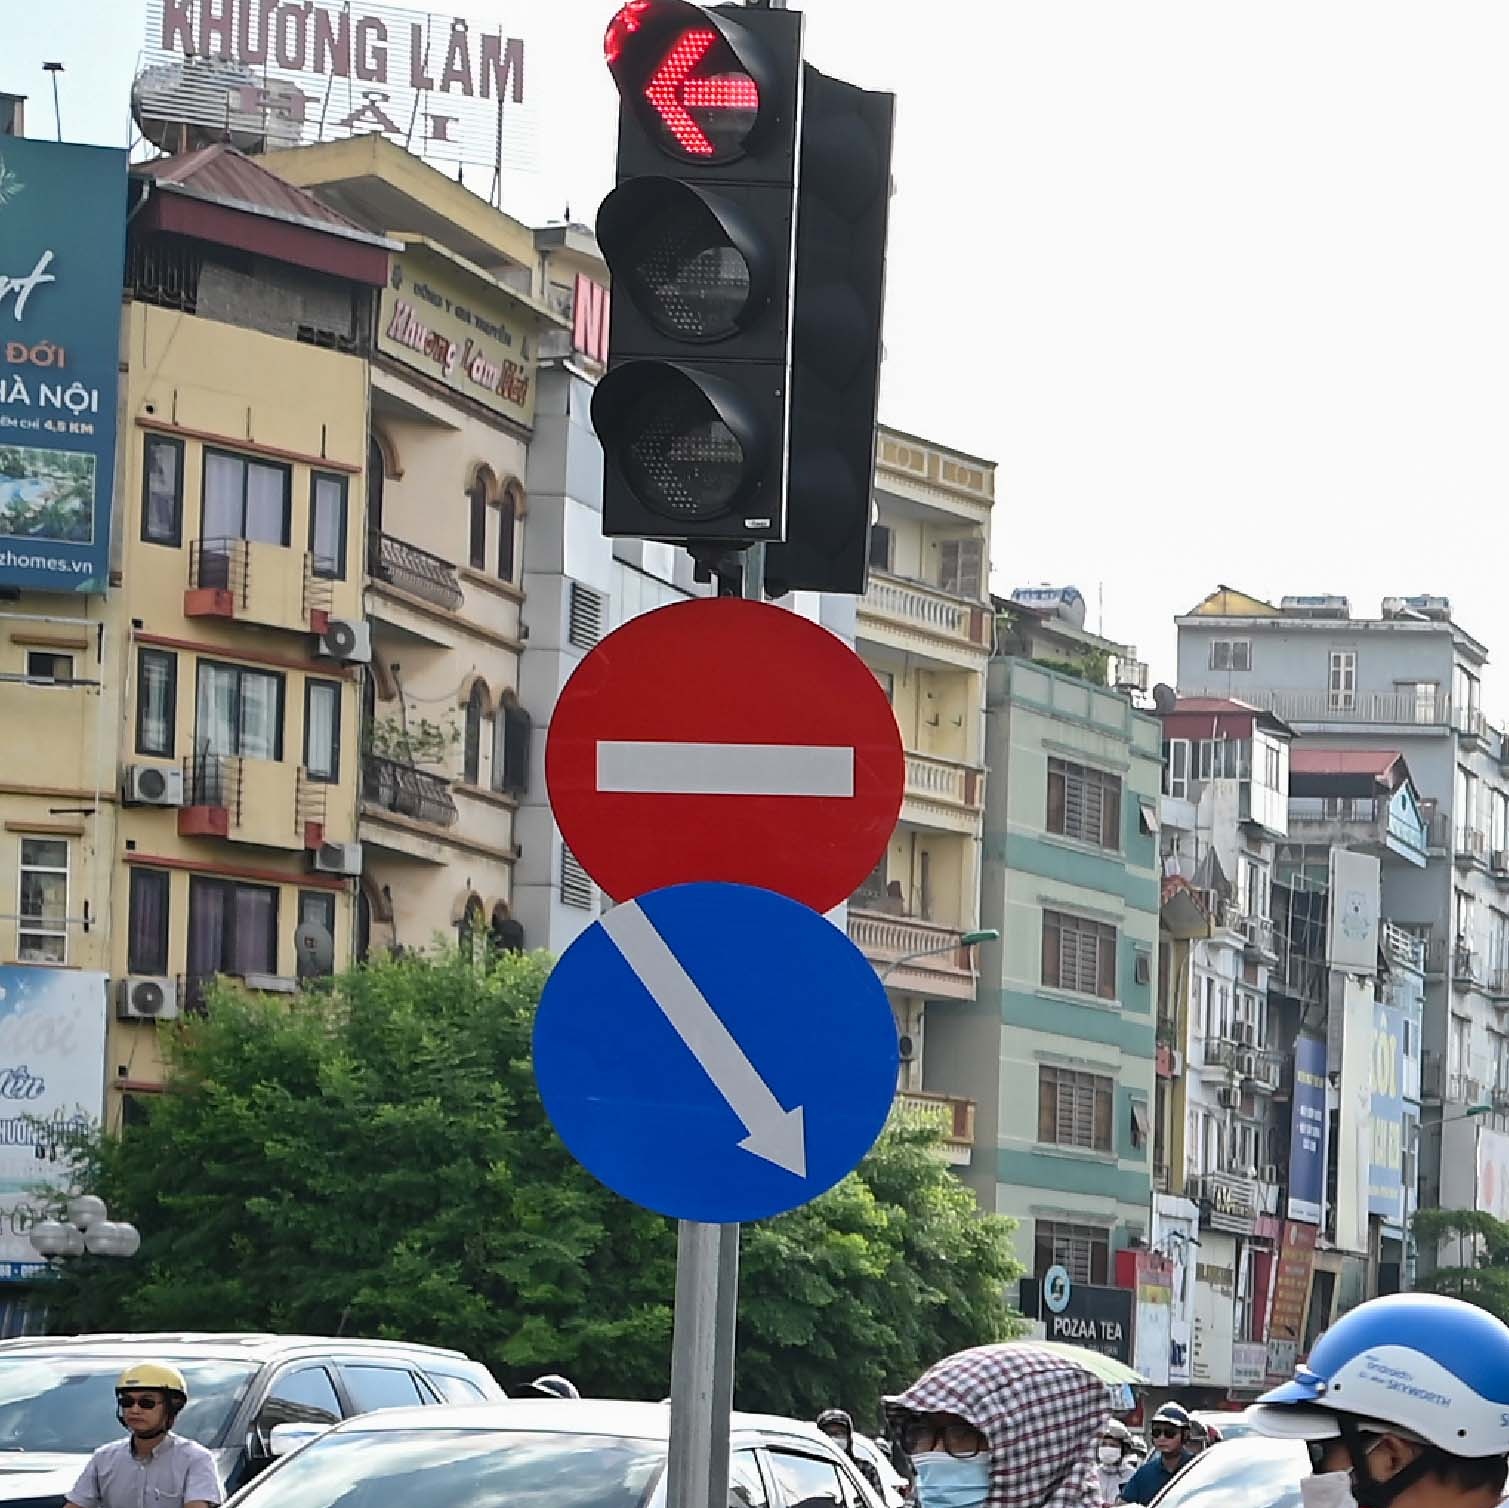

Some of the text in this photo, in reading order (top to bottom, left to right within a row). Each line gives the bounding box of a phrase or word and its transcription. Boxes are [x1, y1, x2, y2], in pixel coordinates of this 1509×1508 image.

[411, 17, 524, 103] LÂM
[39, 381, 98, 415] NỘI
[1053, 1317, 1123, 1341] POZAA TEA
